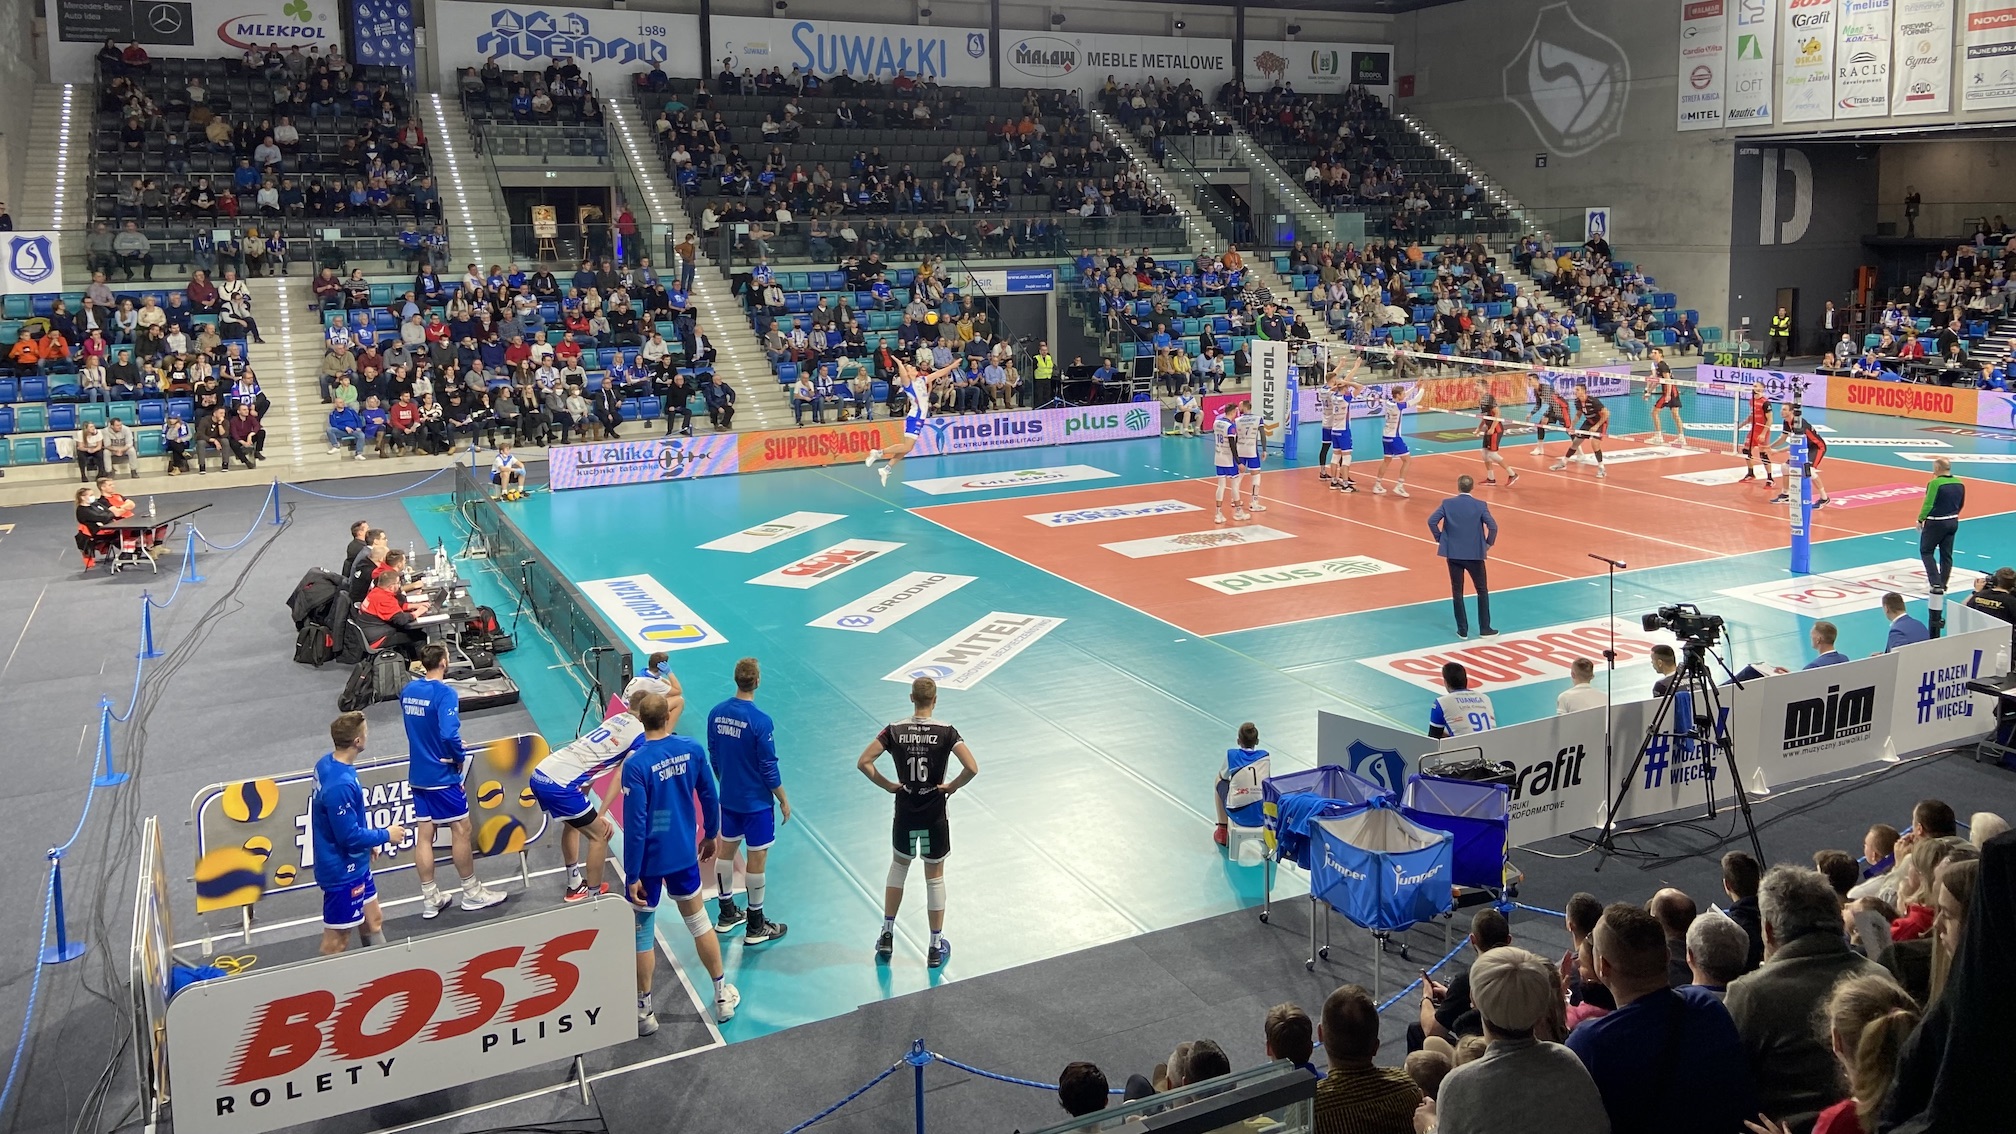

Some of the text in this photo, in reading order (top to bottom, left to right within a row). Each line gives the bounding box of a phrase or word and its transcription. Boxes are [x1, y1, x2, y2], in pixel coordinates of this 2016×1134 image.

[63, 2, 123, 11] Mercedes-Benz
[1853, 0, 1889, 11] melius
[64, 12, 101, 20] Auto Idea
[1796, 10, 1831, 28] Grafit
[236, 23, 326, 39] MLEKPOL
[637, 25, 667, 37] 1989
[792, 21, 946, 78] SUWAŁKI
[1682, 47, 1705, 56] Cardio
[1087, 51, 1224, 70] MEBLE METALOWE
[1904, 55, 1939, 70] Cymes
[1839, 64, 1887, 78] RACIS
[1735, 79, 1764, 93] LOFT
[1909, 82, 1931, 94] AGWO
[1853, 96, 1886, 105] Trans-Kaps
[1687, 110, 1720, 120] MITEL
[1728, 107, 1757, 119] Nautic
[1759, 147, 1814, 246] D
[1713, 353, 1763, 368] 28 KMH
[1263, 346, 1275, 421] KRISPOL
[1847, 384, 1954, 415] SUPROS AGRO
[952, 416, 1043, 440] melius
[1065, 412, 1119, 436] plus
[764, 429, 881, 461] SUPROS AGRO
[953, 436, 1043, 449] CENTRUM REHABILITACJI
[1216, 433, 1224, 444] 18
[603, 446, 655, 463] Alika
[576, 462, 660, 476] kuchnia tatarska
[980, 474, 1070, 486] MLEKPOL
[1212, 567, 1325, 591] plus
[604, 580, 676, 621] LEWIATAN
[866, 574, 948, 614] GRODNO
[931, 617, 1035, 666] MITEL
[1389, 626, 1657, 692] SUPROS
[952, 659, 991, 685] ZDROWIE
[1937, 663, 1968, 684] RAZEM
[1783, 685, 1876, 741] mjm
[1936, 700, 1967, 721] WIĘCEJ
[1467, 712, 1491, 732] 91
[586, 727, 612, 744] 10
[717, 724, 742, 739] SUWAŁKI
[899, 734, 938, 745] FILIPOWICZ
[659, 762, 687, 781] SUWAŁKI
[906, 757, 929, 783] 16
[362, 781, 414, 807] RAZE
[346, 863, 356, 873] 22
[216, 928, 600, 1088] BOSS
[481, 1006, 602, 1054] PLISY
[216, 1057, 396, 1117] ROLETY
